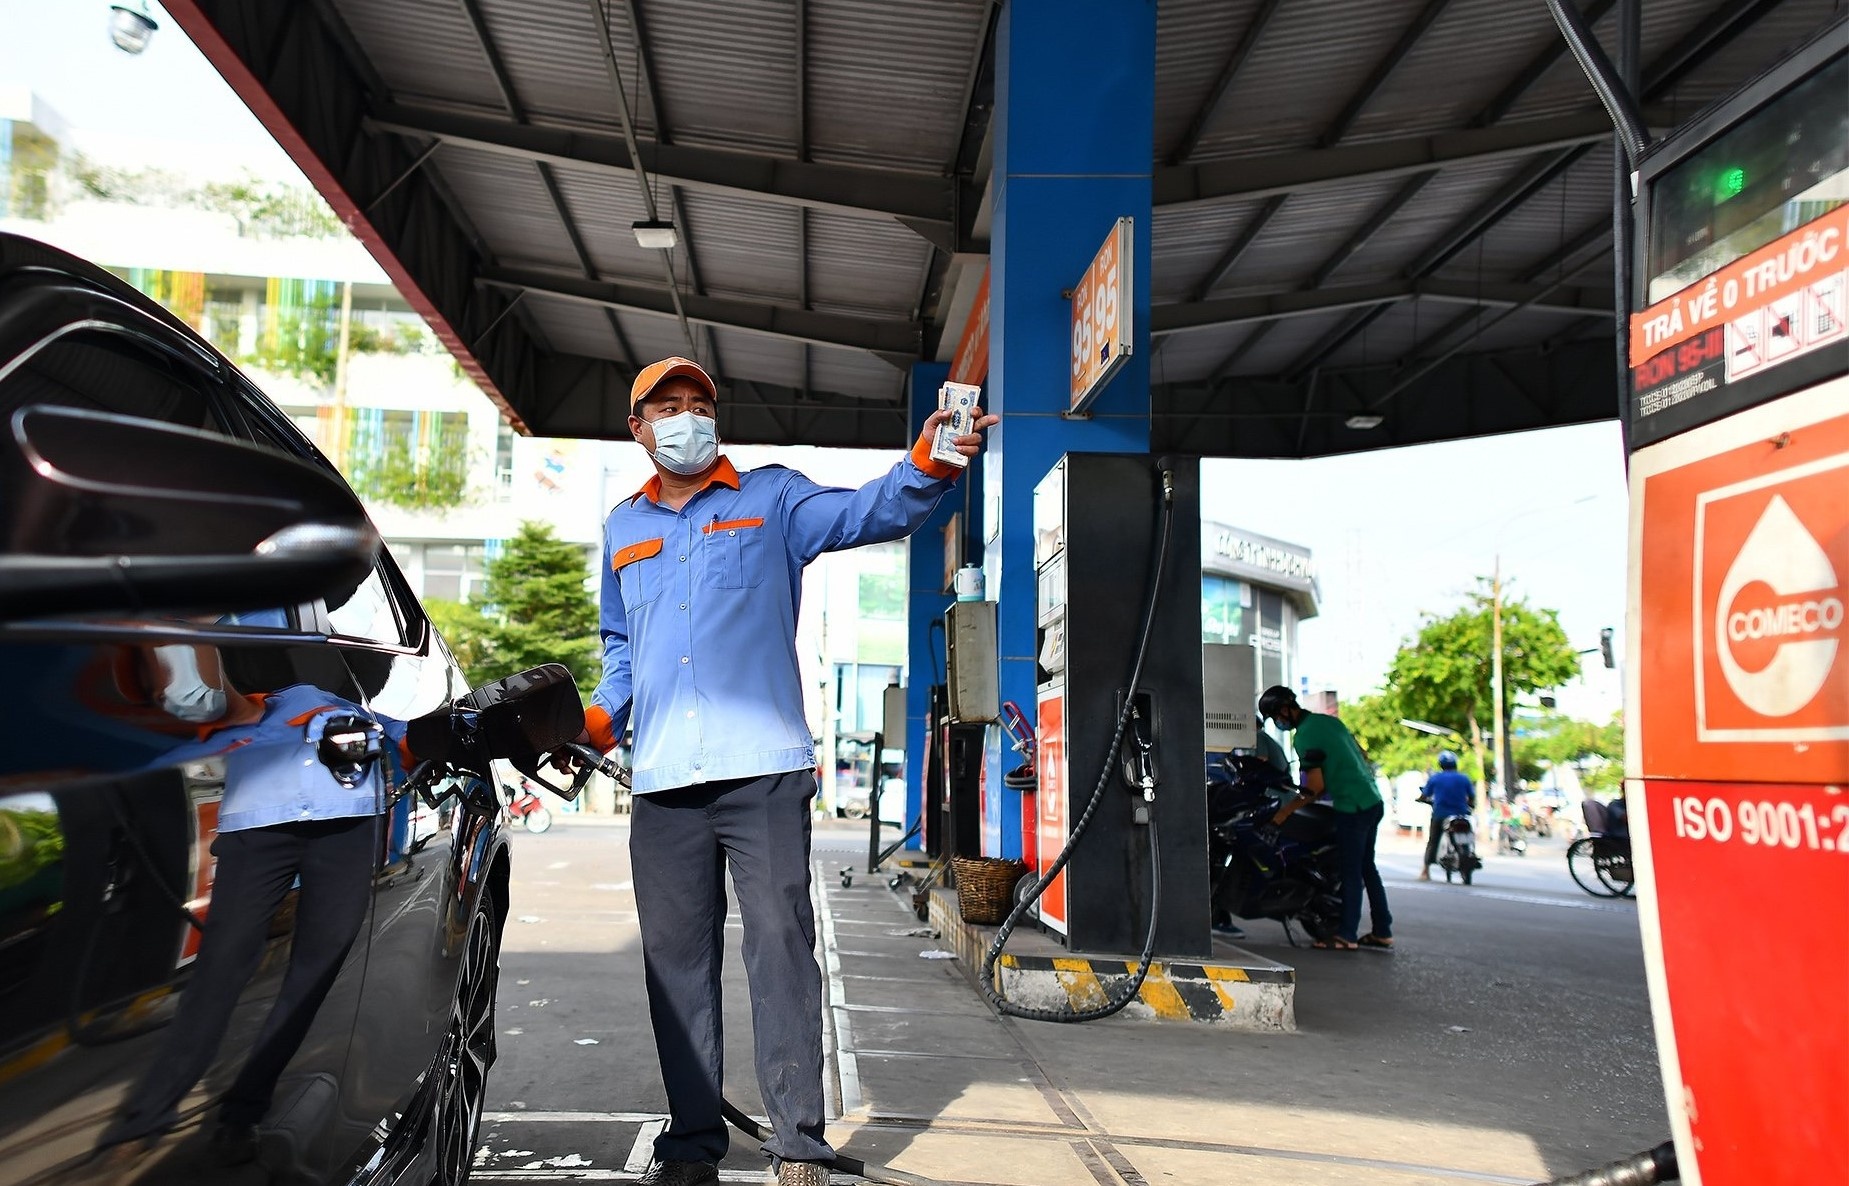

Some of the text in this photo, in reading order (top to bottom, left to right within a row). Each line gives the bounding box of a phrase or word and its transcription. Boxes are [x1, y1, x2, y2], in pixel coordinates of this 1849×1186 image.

[1100, 241, 1113, 277] RON
[1076, 281, 1088, 314] RON
[1095, 265, 1118, 345] 95
[1642, 298, 1684, 347] TRẢ
[1688, 277, 1718, 325] VỀ
[1073, 303, 1092, 376] 95
[1634, 352, 1675, 390] RON
[1728, 597, 1844, 642] COMECO
[1672, 796, 1734, 843] ISO
